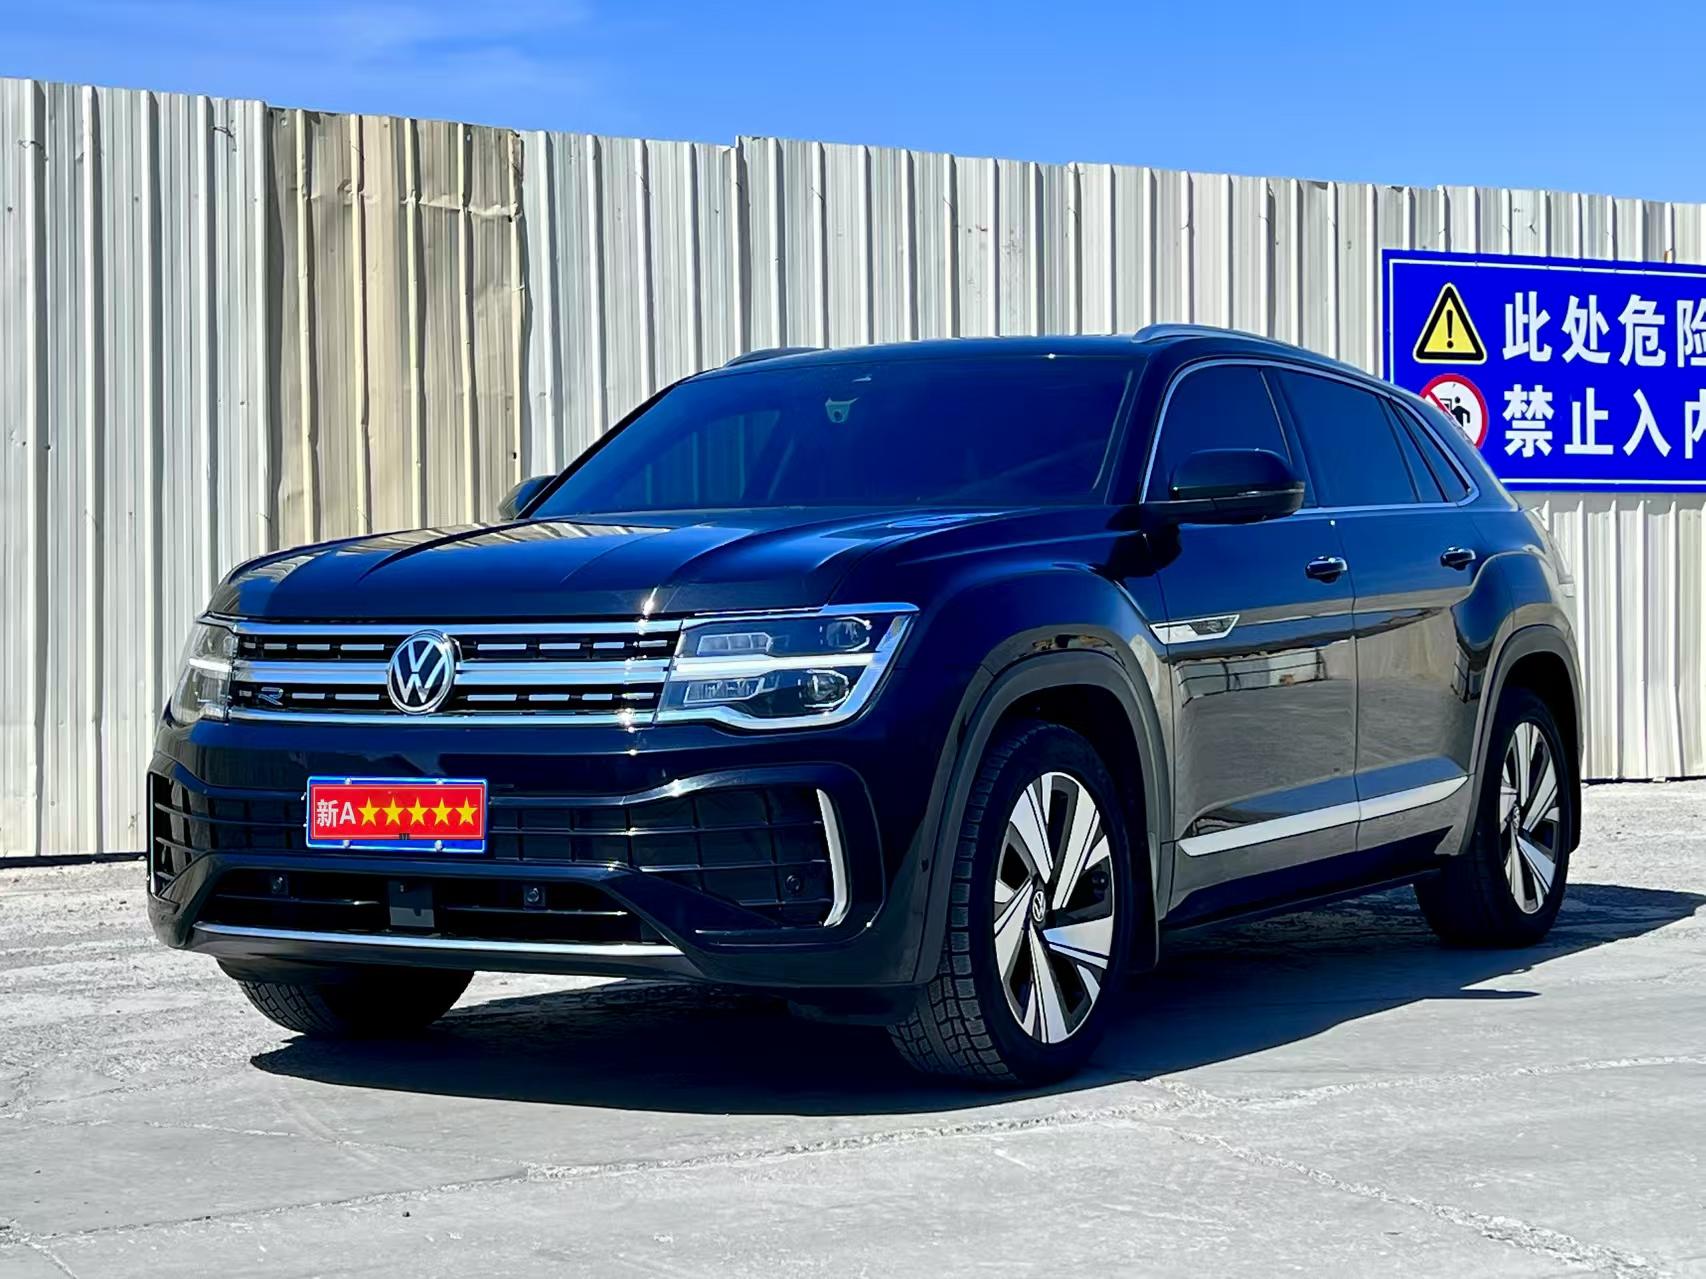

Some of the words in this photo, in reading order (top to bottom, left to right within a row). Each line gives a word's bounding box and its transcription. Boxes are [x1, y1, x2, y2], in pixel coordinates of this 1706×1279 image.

[1503, 291, 1706, 368] 此处危险
[393, 636, 448, 704] VW
